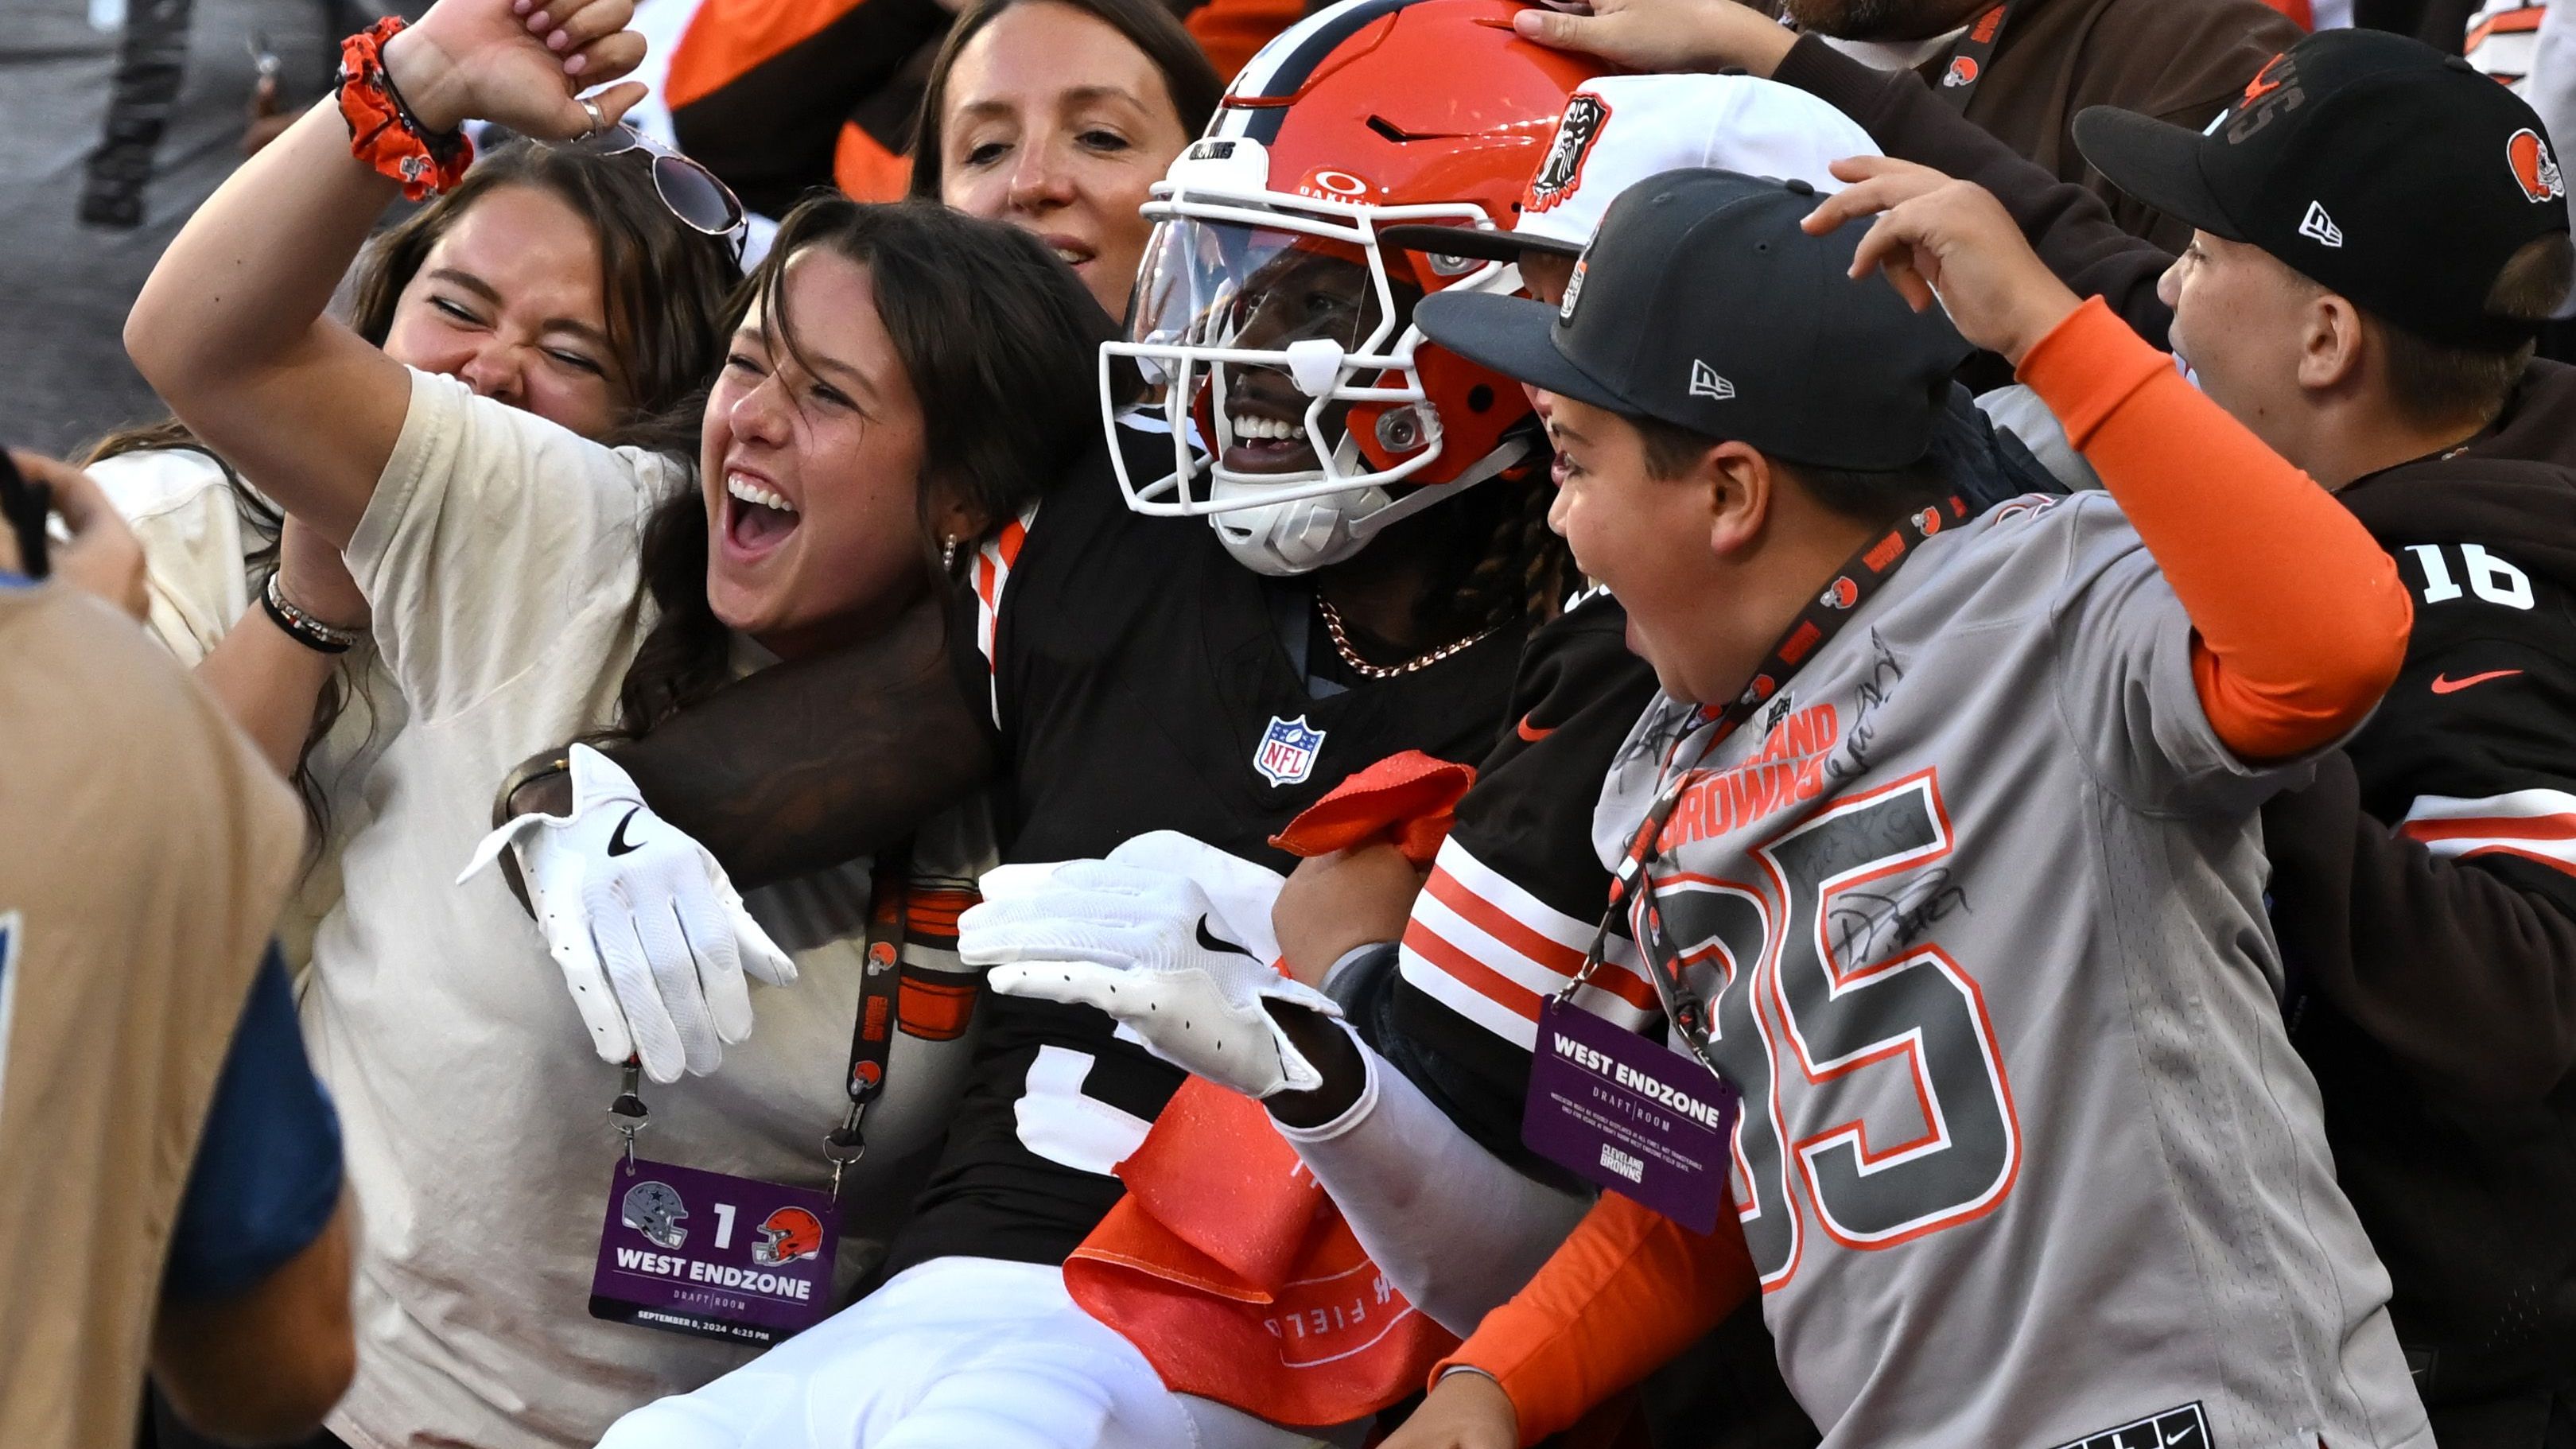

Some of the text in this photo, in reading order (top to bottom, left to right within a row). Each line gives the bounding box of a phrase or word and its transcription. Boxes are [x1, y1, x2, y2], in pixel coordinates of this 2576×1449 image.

[2403, 543, 2535, 611] 16
[1263, 741, 1303, 774] NFL
[1553, 1031, 1719, 1129] WEST ENDZONE
[1592, 1086, 1670, 1132] DRAFT ROOM
[1599, 1153, 1642, 1184] BROWNS
[1602, 1142, 1644, 1171] CLEVELAND
[713, 1202, 736, 1249] 1
[616, 1247, 811, 1300] WEST ENDZONE
[674, 1289, 745, 1311] DRAFT ROOM
[638, 1310, 690, 1327] SEPTEMBER
[702, 1322, 727, 1333] 2024
[732, 1327, 753, 1338] 4:25
[755, 1331, 770, 1341] PM
